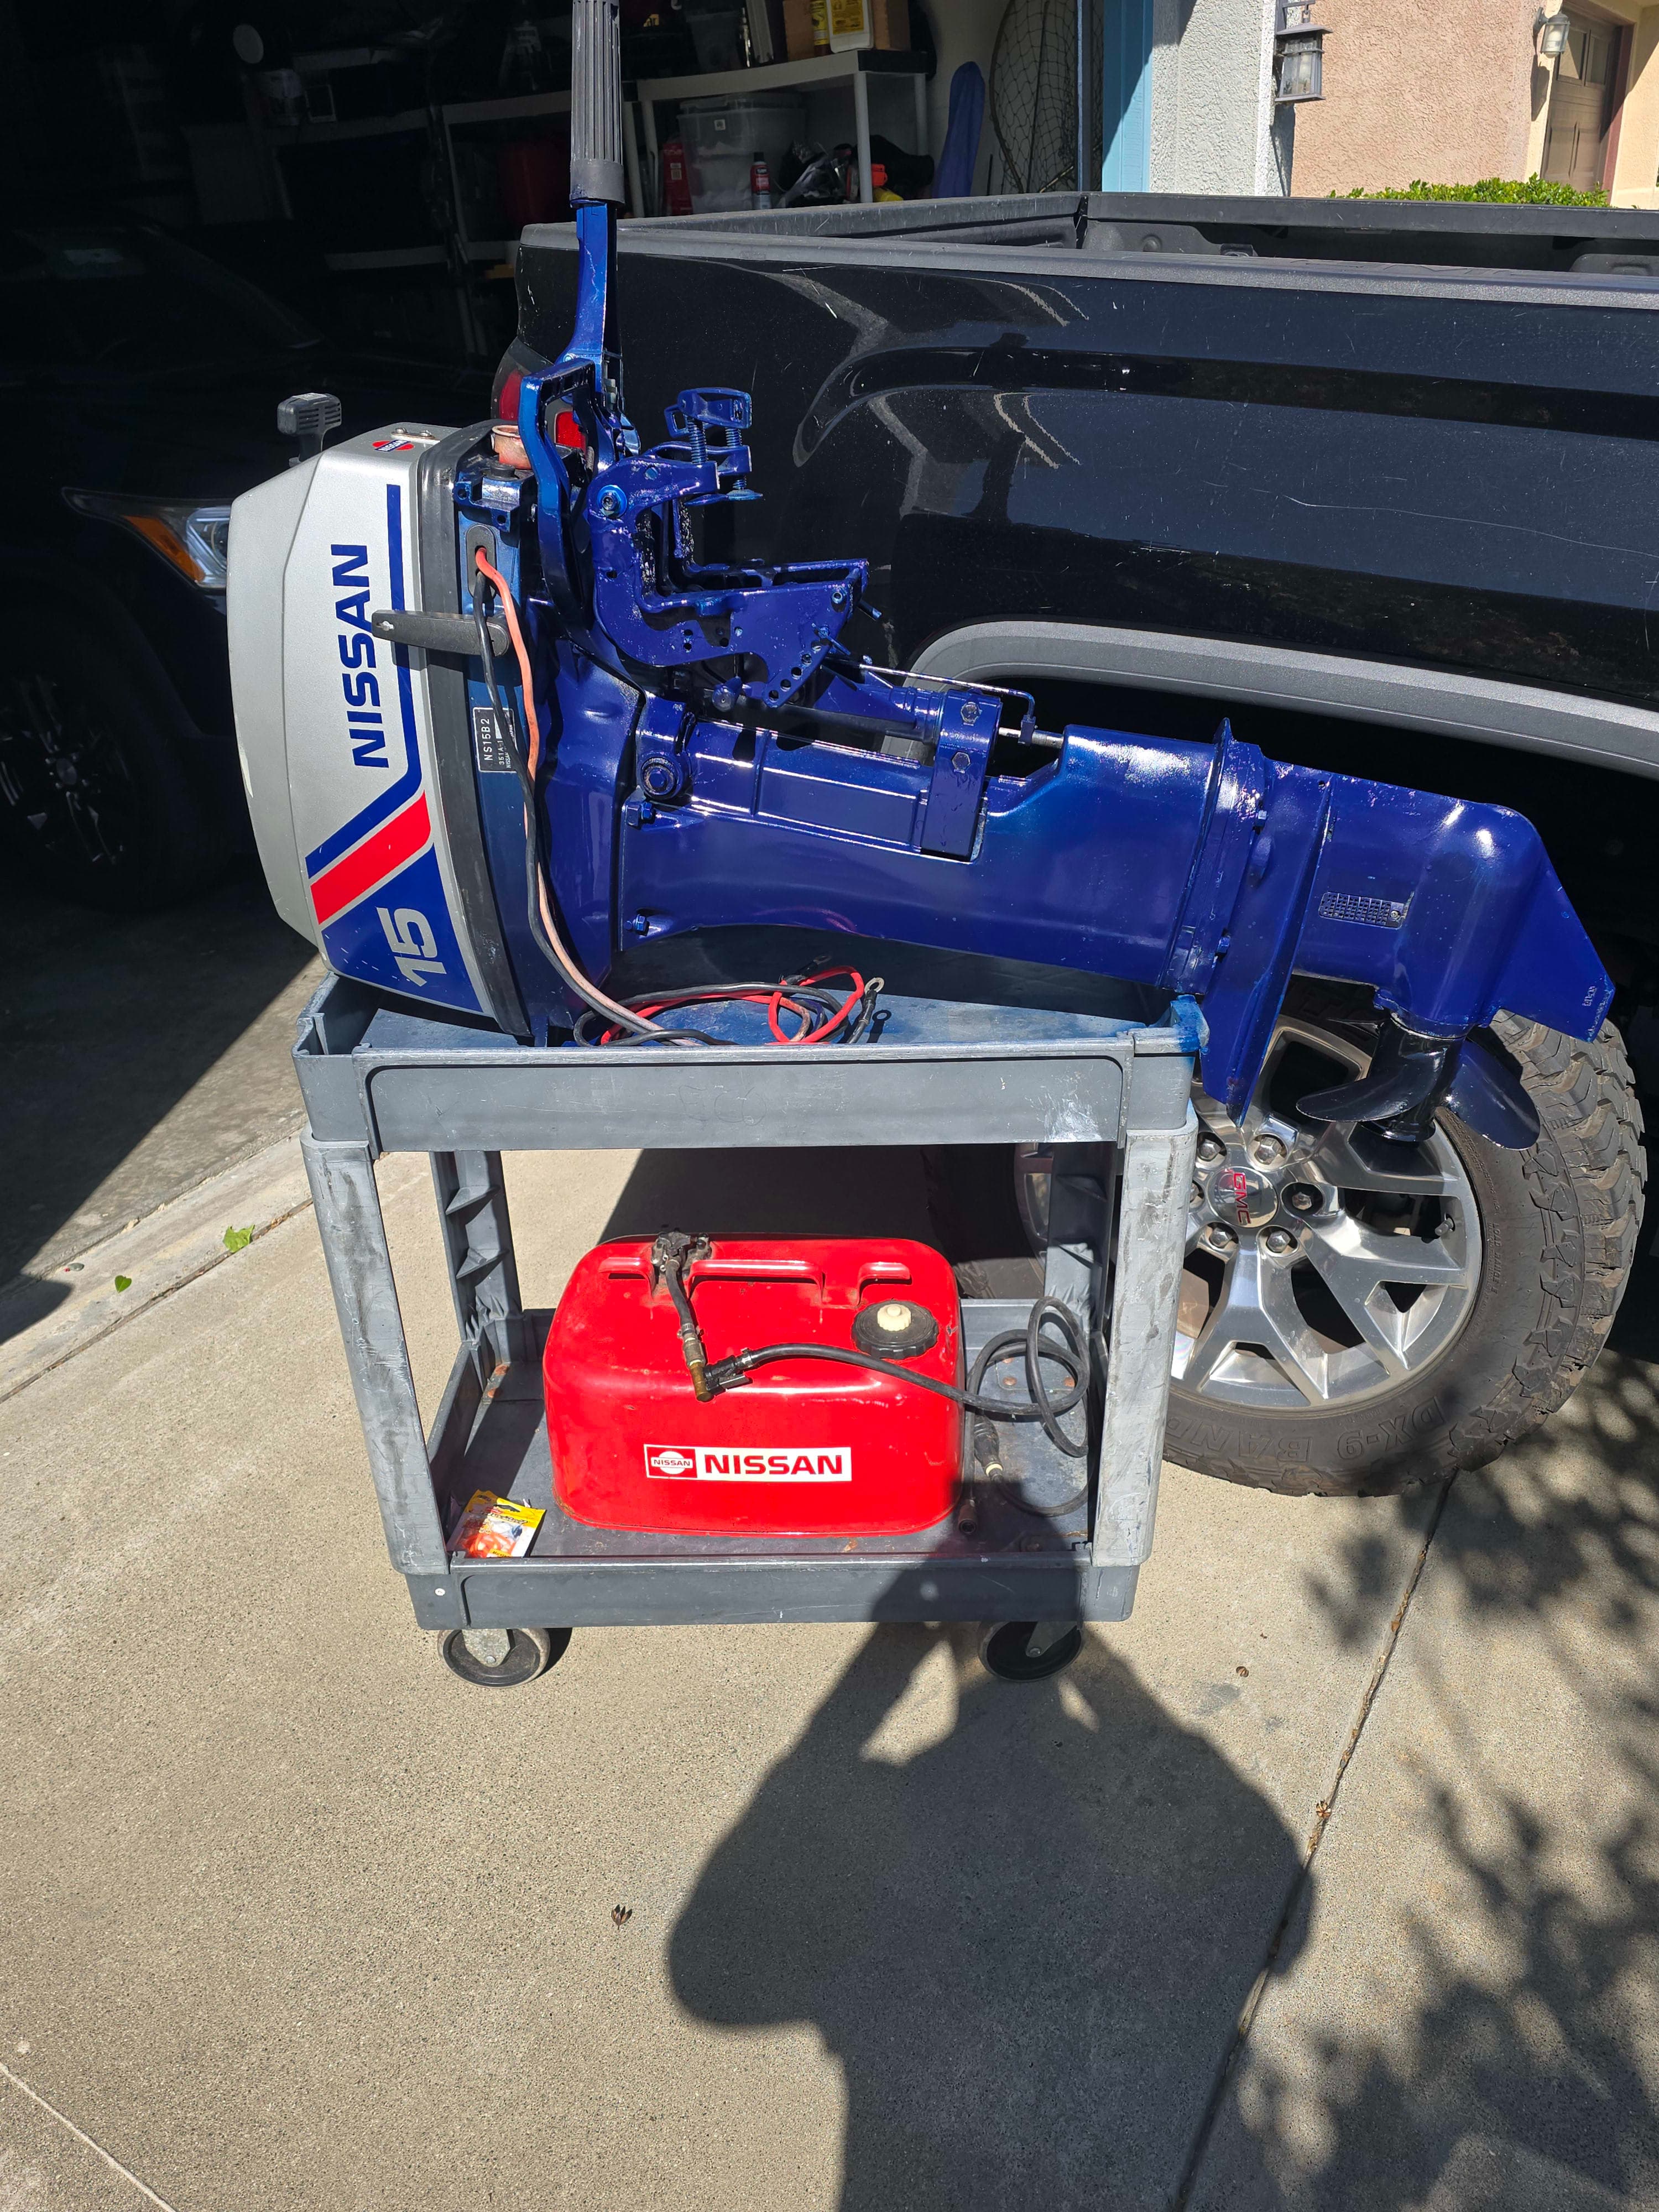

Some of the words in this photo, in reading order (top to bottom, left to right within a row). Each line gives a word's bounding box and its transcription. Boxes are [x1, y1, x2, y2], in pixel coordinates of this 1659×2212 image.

[331, 544, 389, 768] NISSAN
[481, 719, 493, 760] NS15B2
[376, 907, 447, 987] 15
[1233, 1172, 1252, 1224] GMC
[1492, 1221, 1502, 1248] LOAD
[1337, 1396, 1446, 1460] DX-9
[705, 1454, 843, 1475] NISSAN
